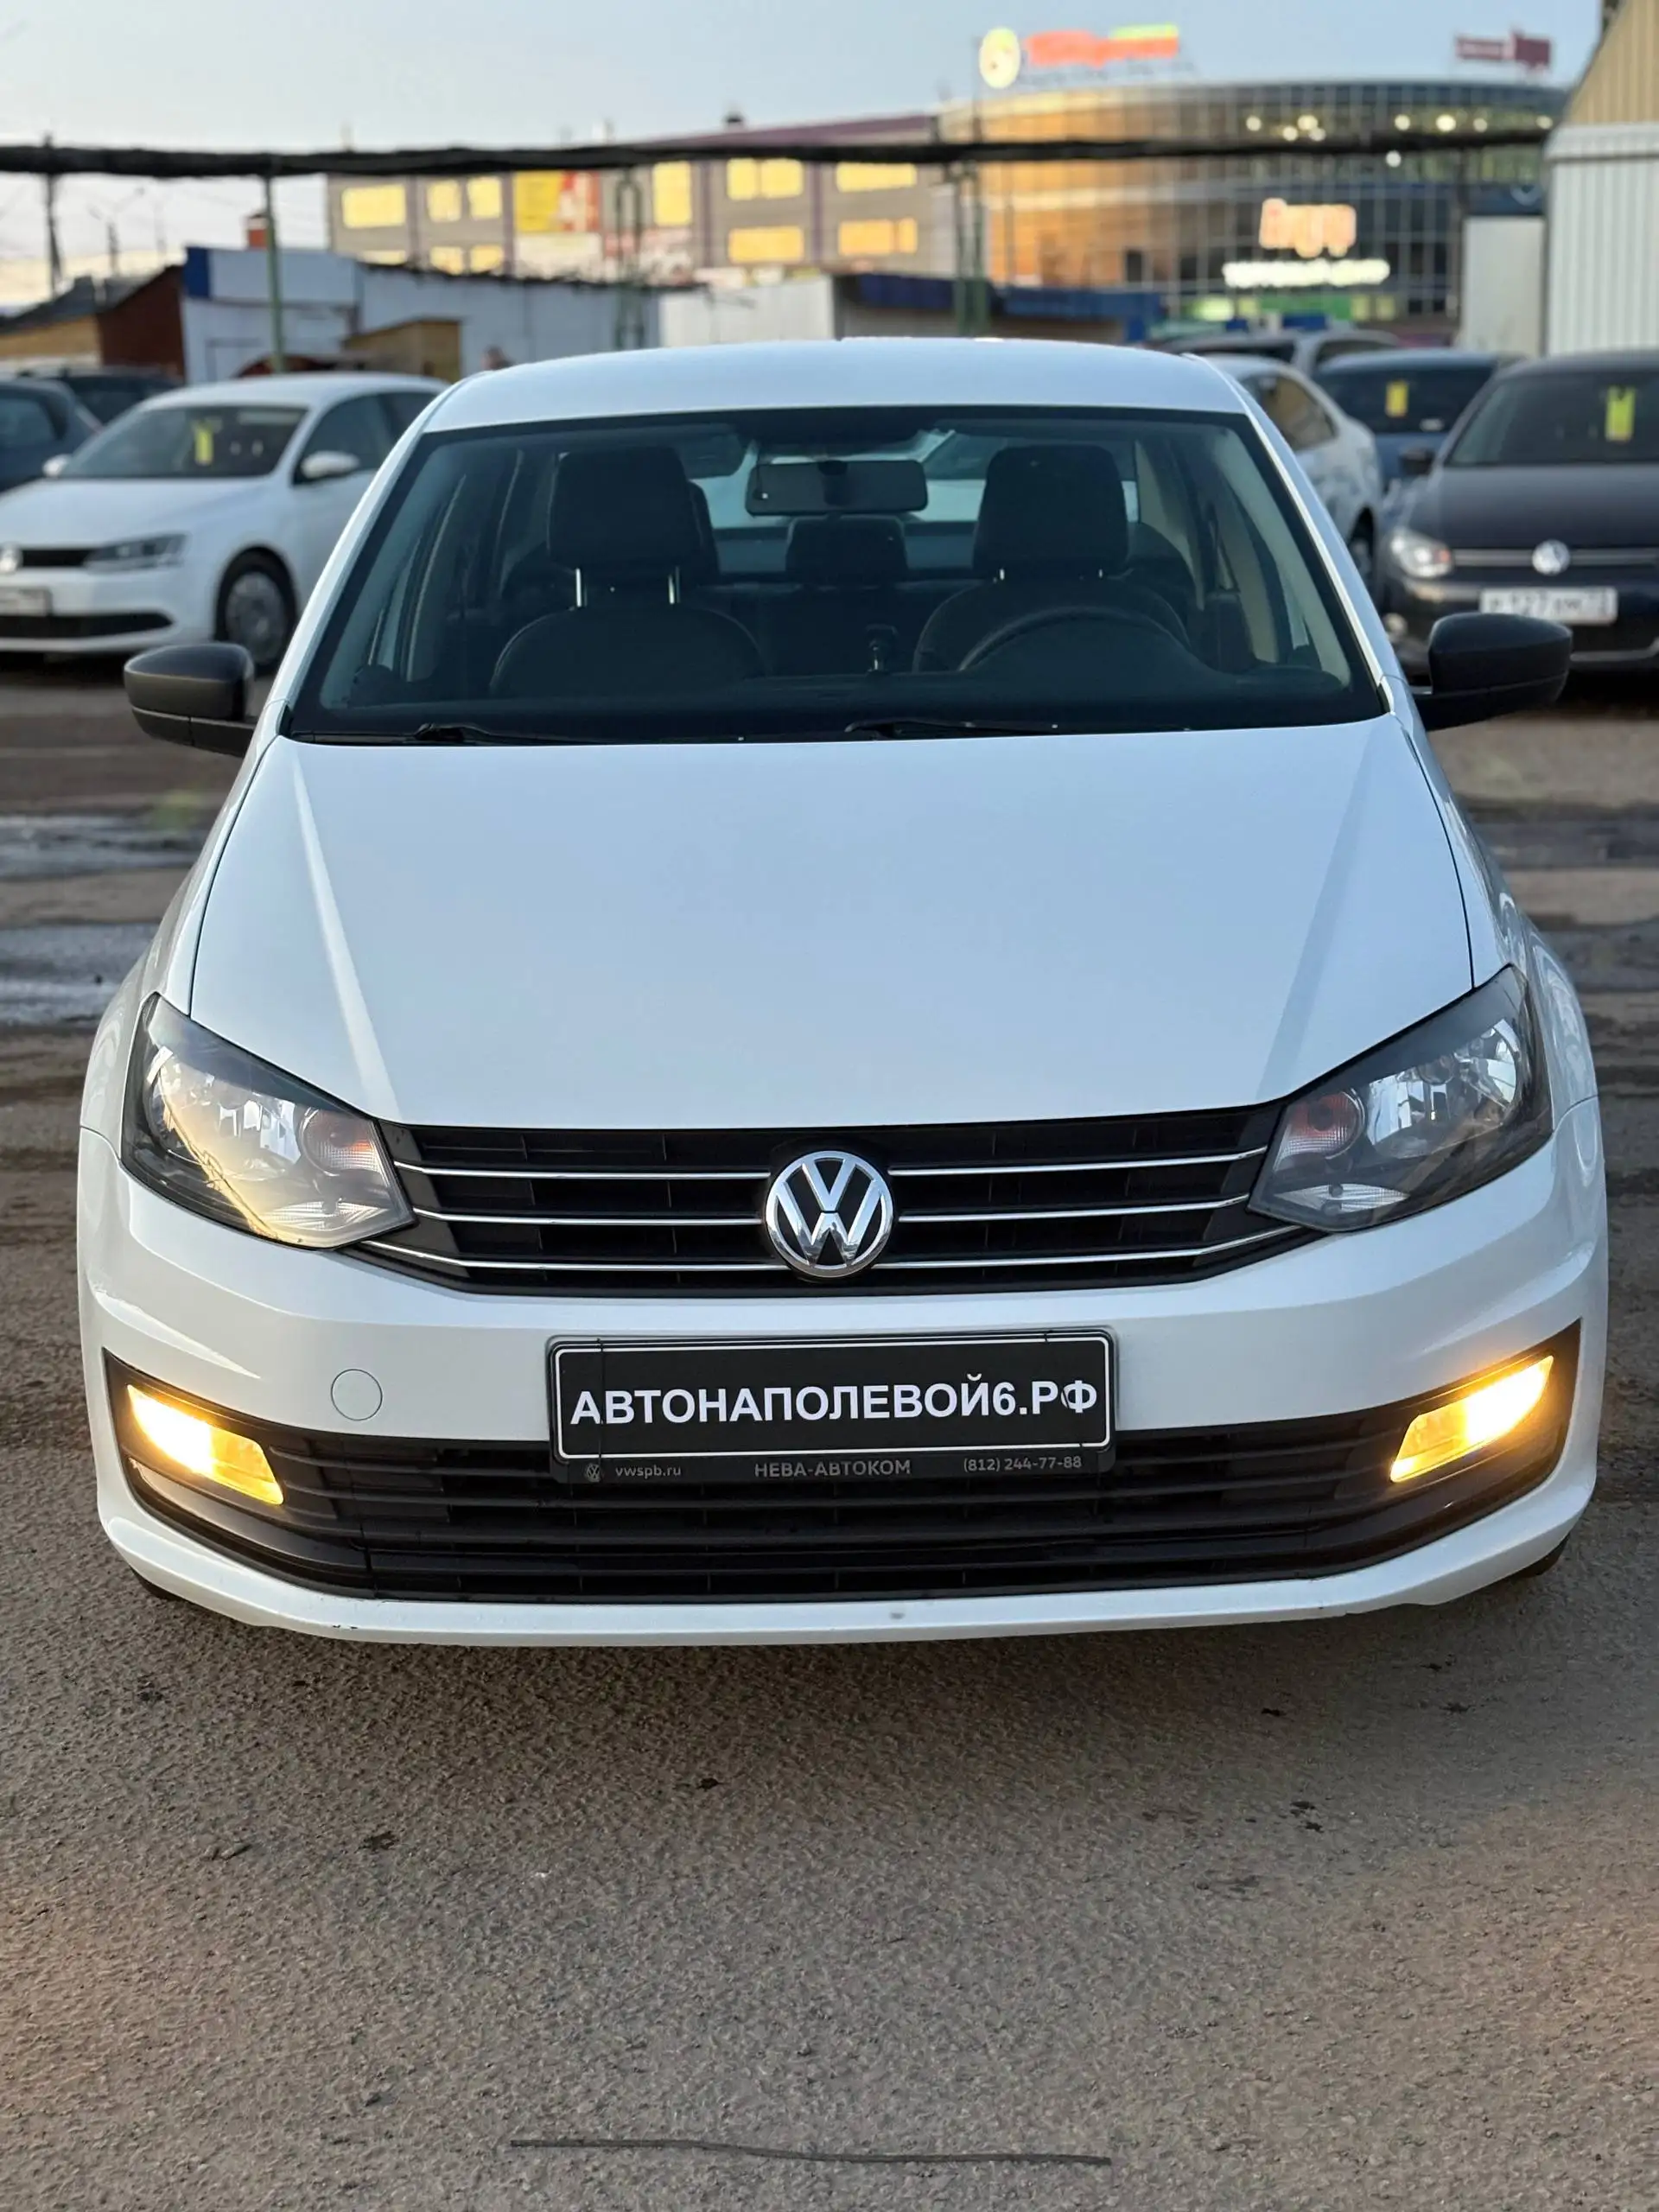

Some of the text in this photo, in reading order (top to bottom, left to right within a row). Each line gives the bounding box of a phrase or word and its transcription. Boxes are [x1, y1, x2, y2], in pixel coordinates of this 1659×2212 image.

[766, 1150, 893, 1278] VW
[570, 1372, 1099, 1425] АВТОНАПОЛЕВОЙ6.РФ
[614, 1465, 682, 1479] vwspb.ru
[753, 1459, 911, 1478] НЕВА-АВТОКОМ
[963, 1456, 1082, 1471] (812) 244-77-88
